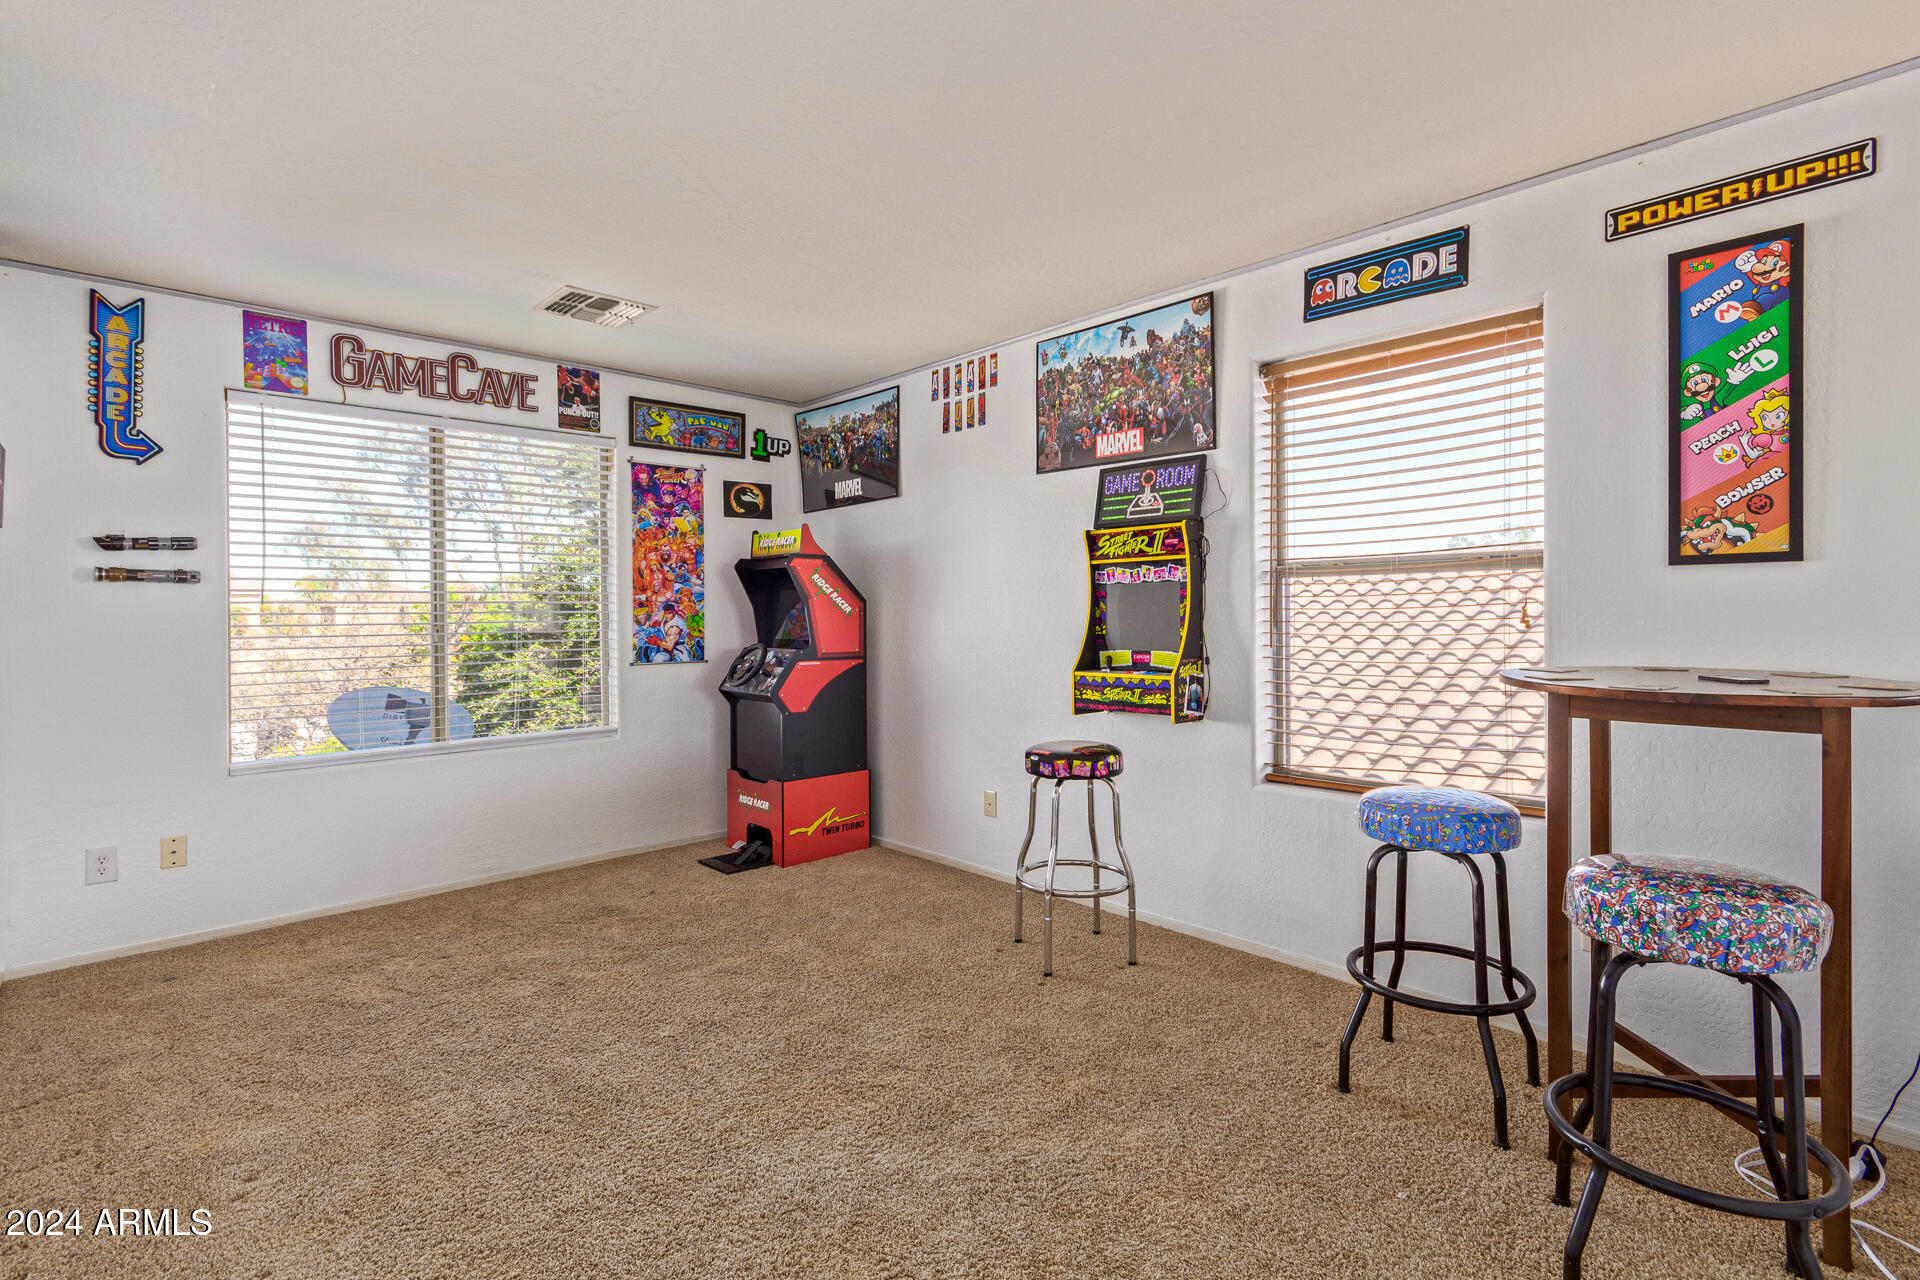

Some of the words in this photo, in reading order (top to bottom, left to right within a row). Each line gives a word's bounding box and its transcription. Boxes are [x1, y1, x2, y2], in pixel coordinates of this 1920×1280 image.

[1617, 181, 1749, 233] POWER
[1766, 151, 1861, 193] UP!!!
[1310, 243, 1458, 307] ARCADE
[1689, 278, 1744, 319] MARIO
[1719, 303, 1740, 321] M
[245, 314, 304, 337] TETRIS
[1727, 325, 1780, 361] LUIGI
[104, 315, 131, 421] ARCADE
[1753, 355, 1775, 369] L
[687, 417, 730, 430] PAC-MAN
[1688, 420, 1742, 455] PEACH
[1097, 429, 1144, 457] MARVEL
[835, 477, 863, 499] MARVEL
[1105, 472, 1141, 495] GAME
[1156, 463, 1196, 489] ROOM
[1714, 466, 1787, 509] BOWSER
[1096, 531, 1133, 556] STREET
[1103, 535, 1153, 558] FIGHTER
[811, 573, 833, 594] RIDGE
[830, 592, 852, 614] RACER
[753, 798, 770, 811] RACER
[821, 825, 840, 836] TWIN
[841, 820, 865, 833] TURBO
